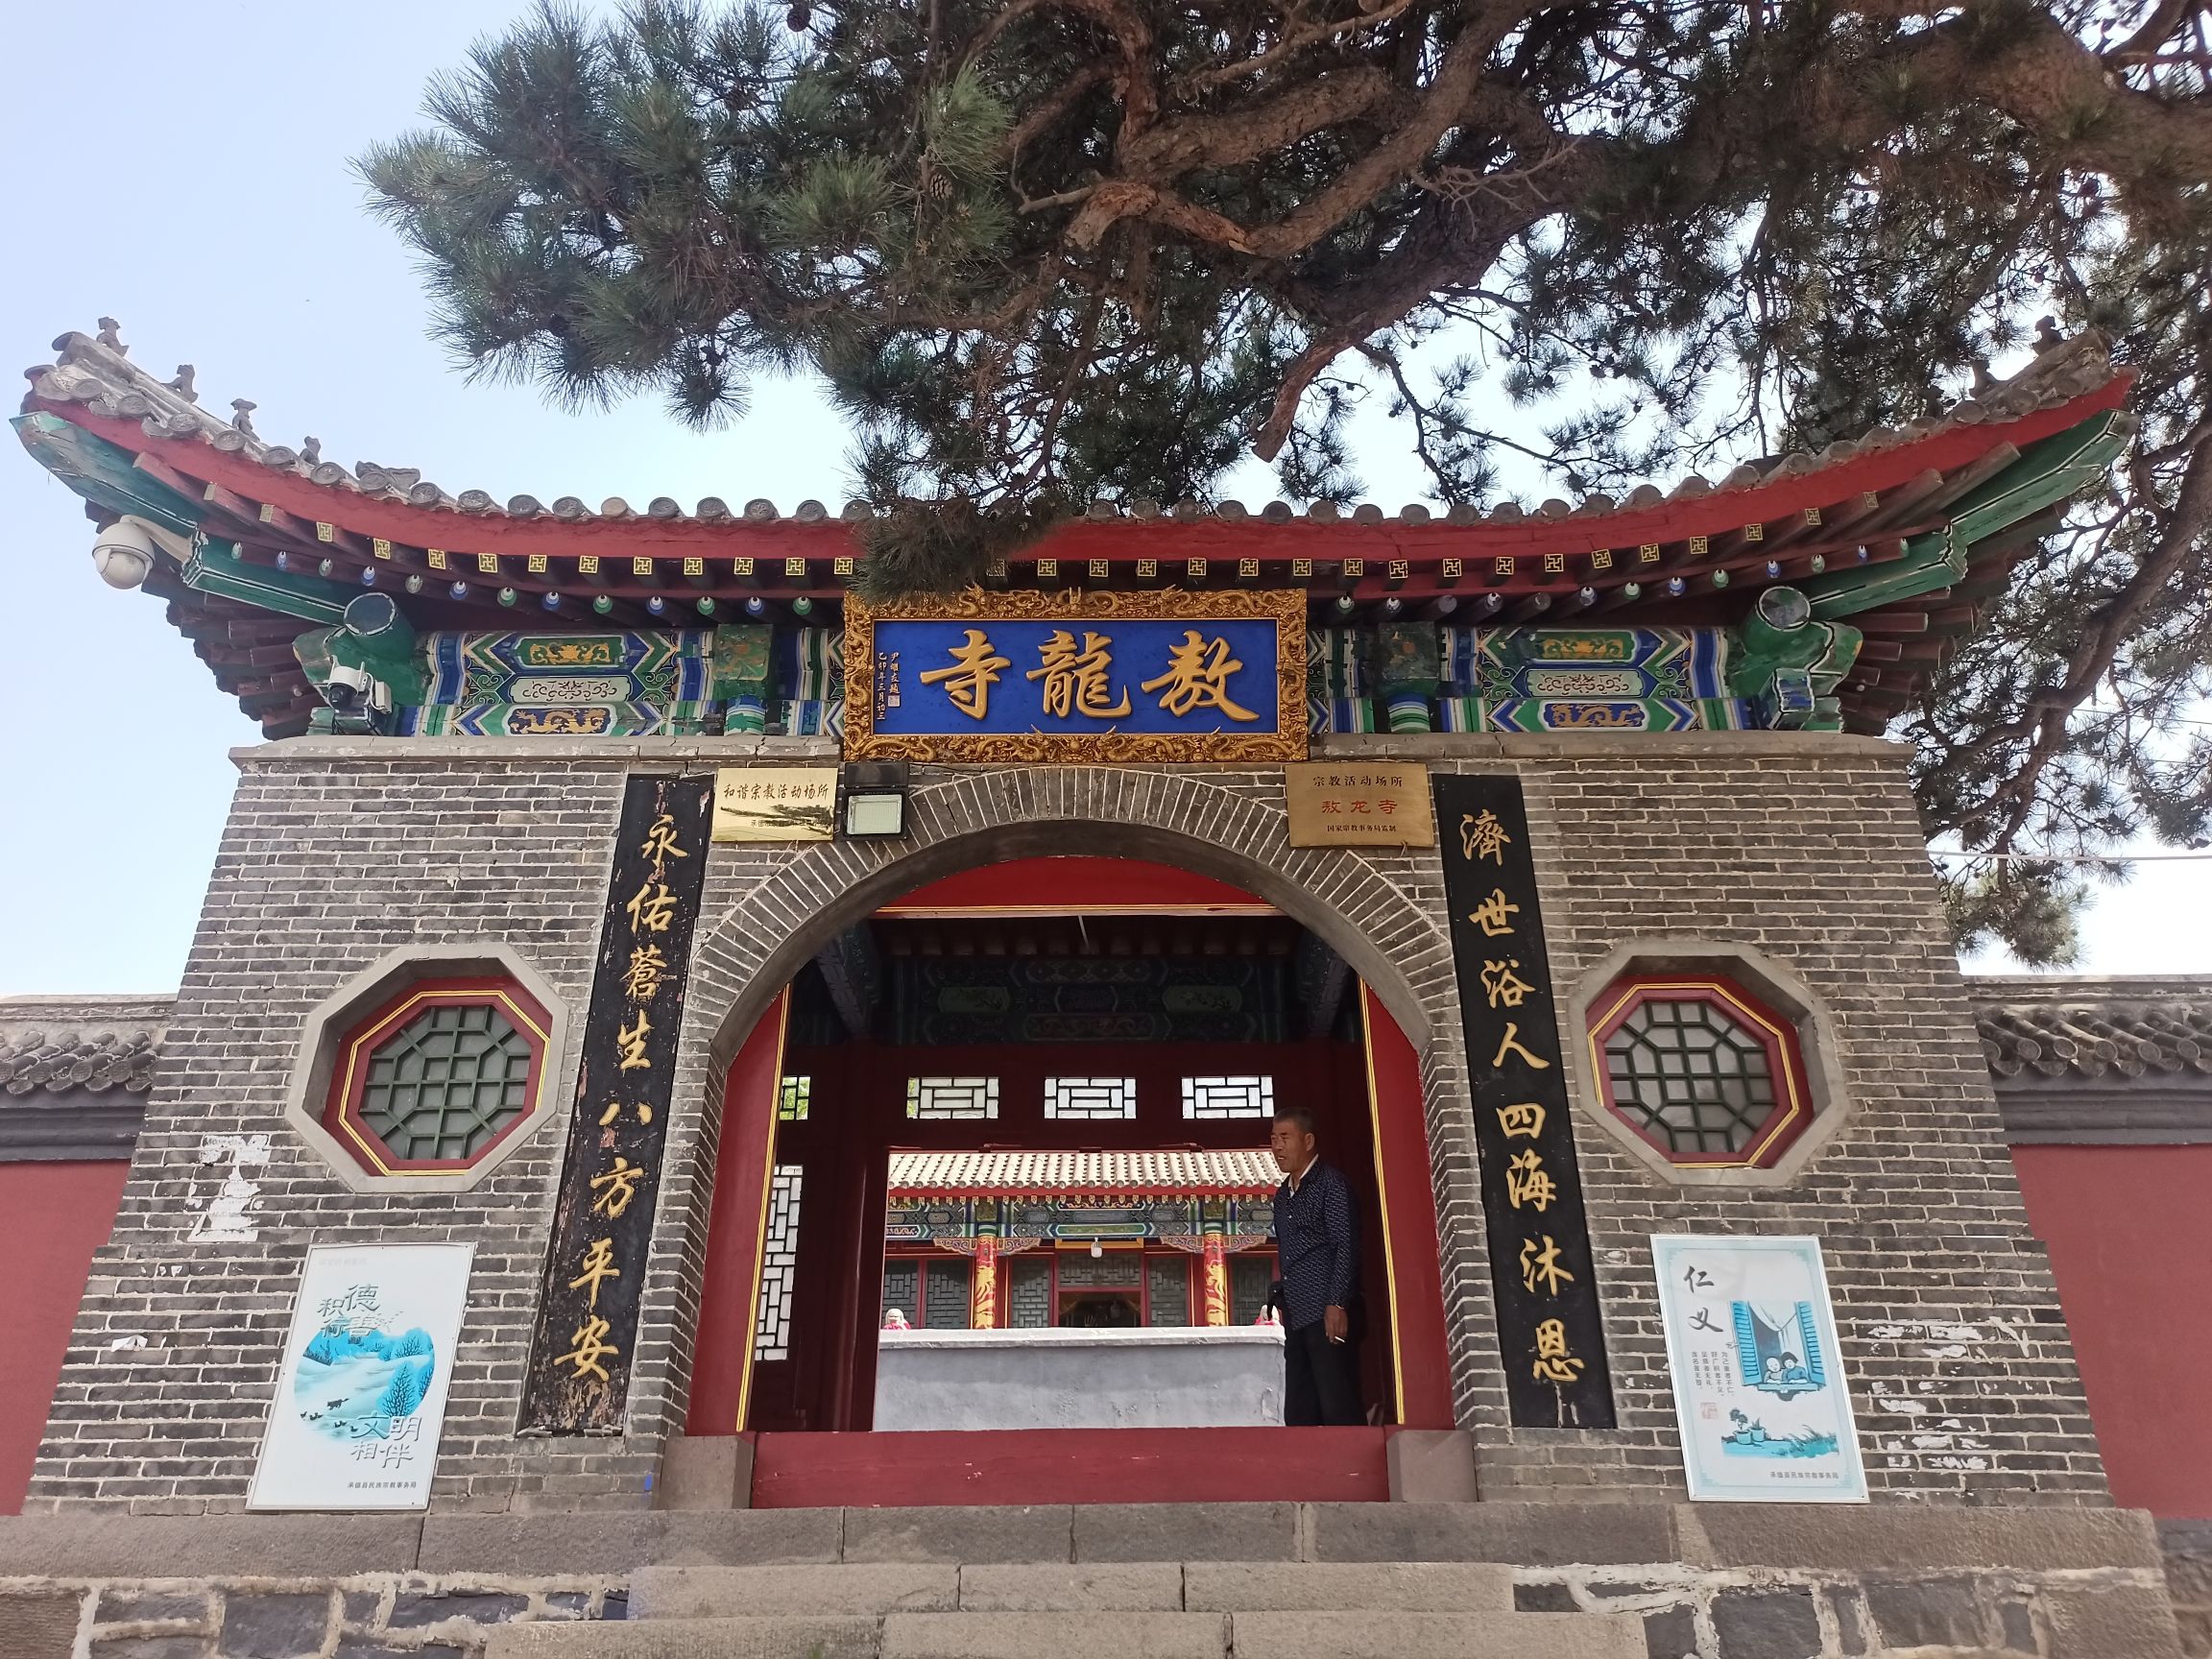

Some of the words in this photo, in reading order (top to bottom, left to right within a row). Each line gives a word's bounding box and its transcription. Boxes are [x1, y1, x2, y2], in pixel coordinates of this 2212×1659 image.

[920, 629, 1261, 722] 敖龍寺
[723, 783, 830, 801] 和谐宗教活动场所
[1312, 775, 1403, 787] 宗教活动场所
[1321, 799, 1398, 814] 敖龙寺
[1327, 824, 1397, 832] 国家宗教事务局监制
[553, 813, 689, 1382] 永佑蒼生八方平安
[317, 1284, 381, 1317] 积德
[1683, 1265, 1724, 1333] 仁义
[349, 1410, 423, 1442] 文明
[349, 1441, 415, 1470] 相伴
